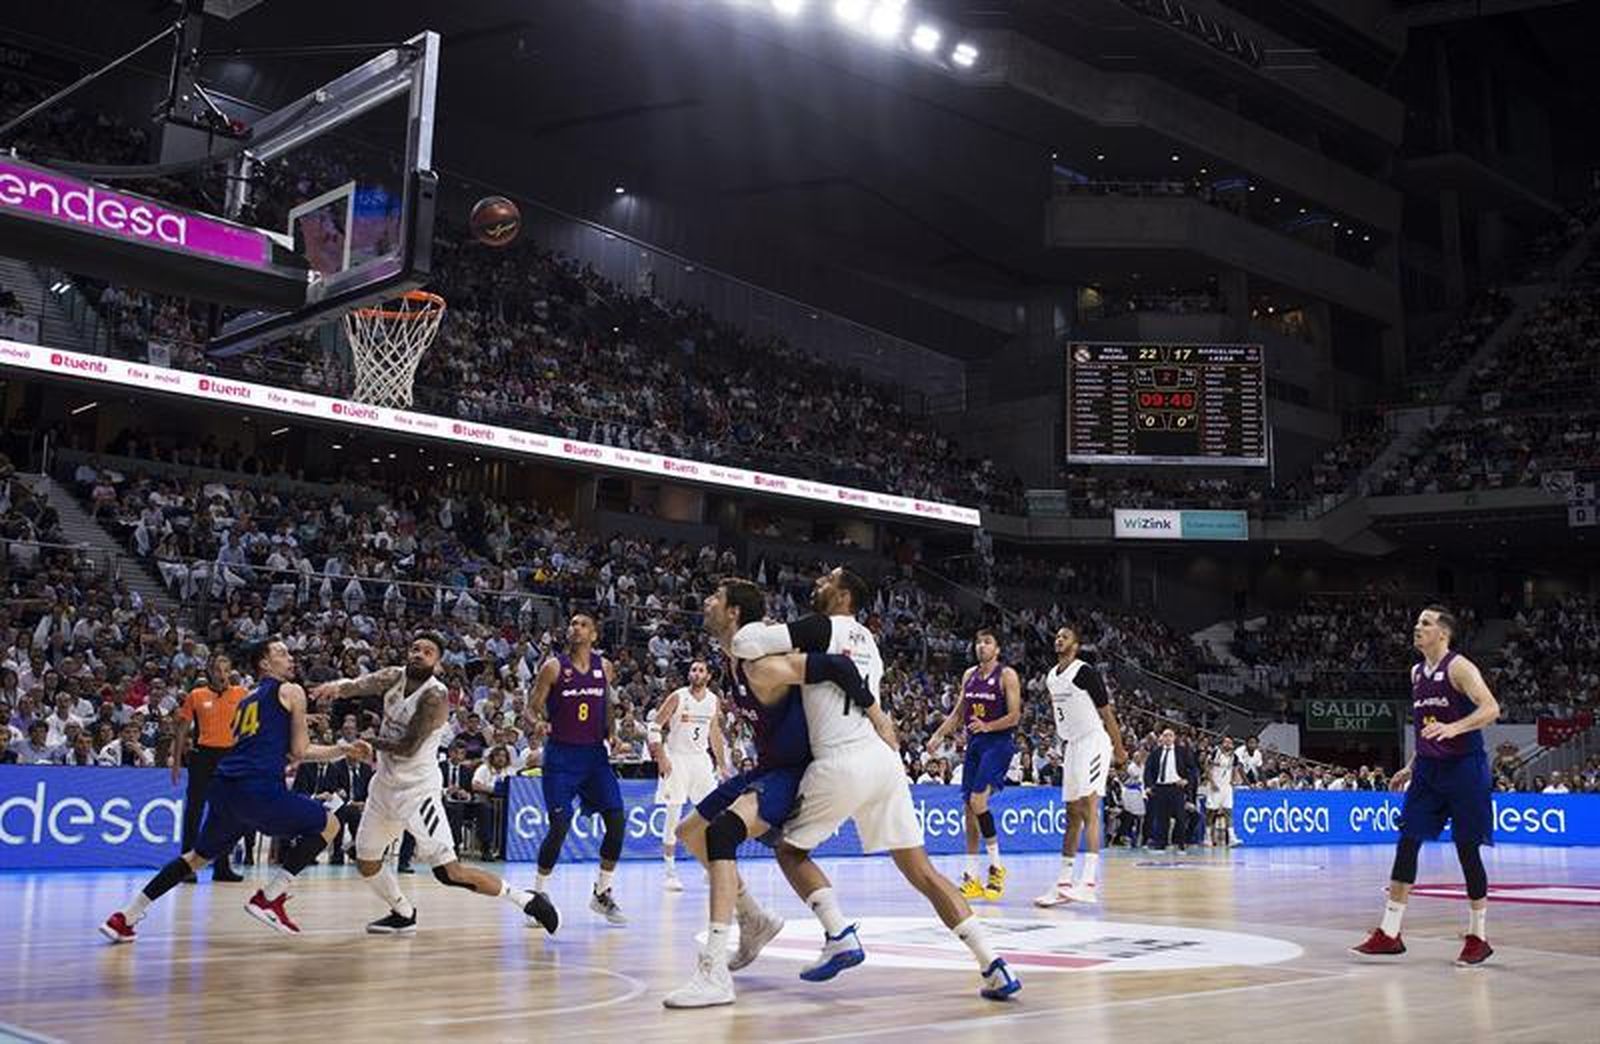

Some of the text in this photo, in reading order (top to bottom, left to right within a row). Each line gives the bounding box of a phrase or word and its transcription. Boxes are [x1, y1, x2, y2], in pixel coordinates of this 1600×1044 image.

[0, 173, 188, 245] endesa
[1139, 348, 1157, 360] 22
[1174, 348, 1192, 361] 17
[63, 355, 108, 374] tuenti
[211, 381, 251, 399] tuenti
[1123, 517, 1172, 530] WiZink
[578, 702, 589, 721] 8
[1056, 707, 1065, 722] 3
[1311, 701, 1393, 718] SALIDA
[1333, 717, 1371, 730] EXIT
[692, 726, 700, 741] 5
[1243, 799, 1329, 833] endesa
